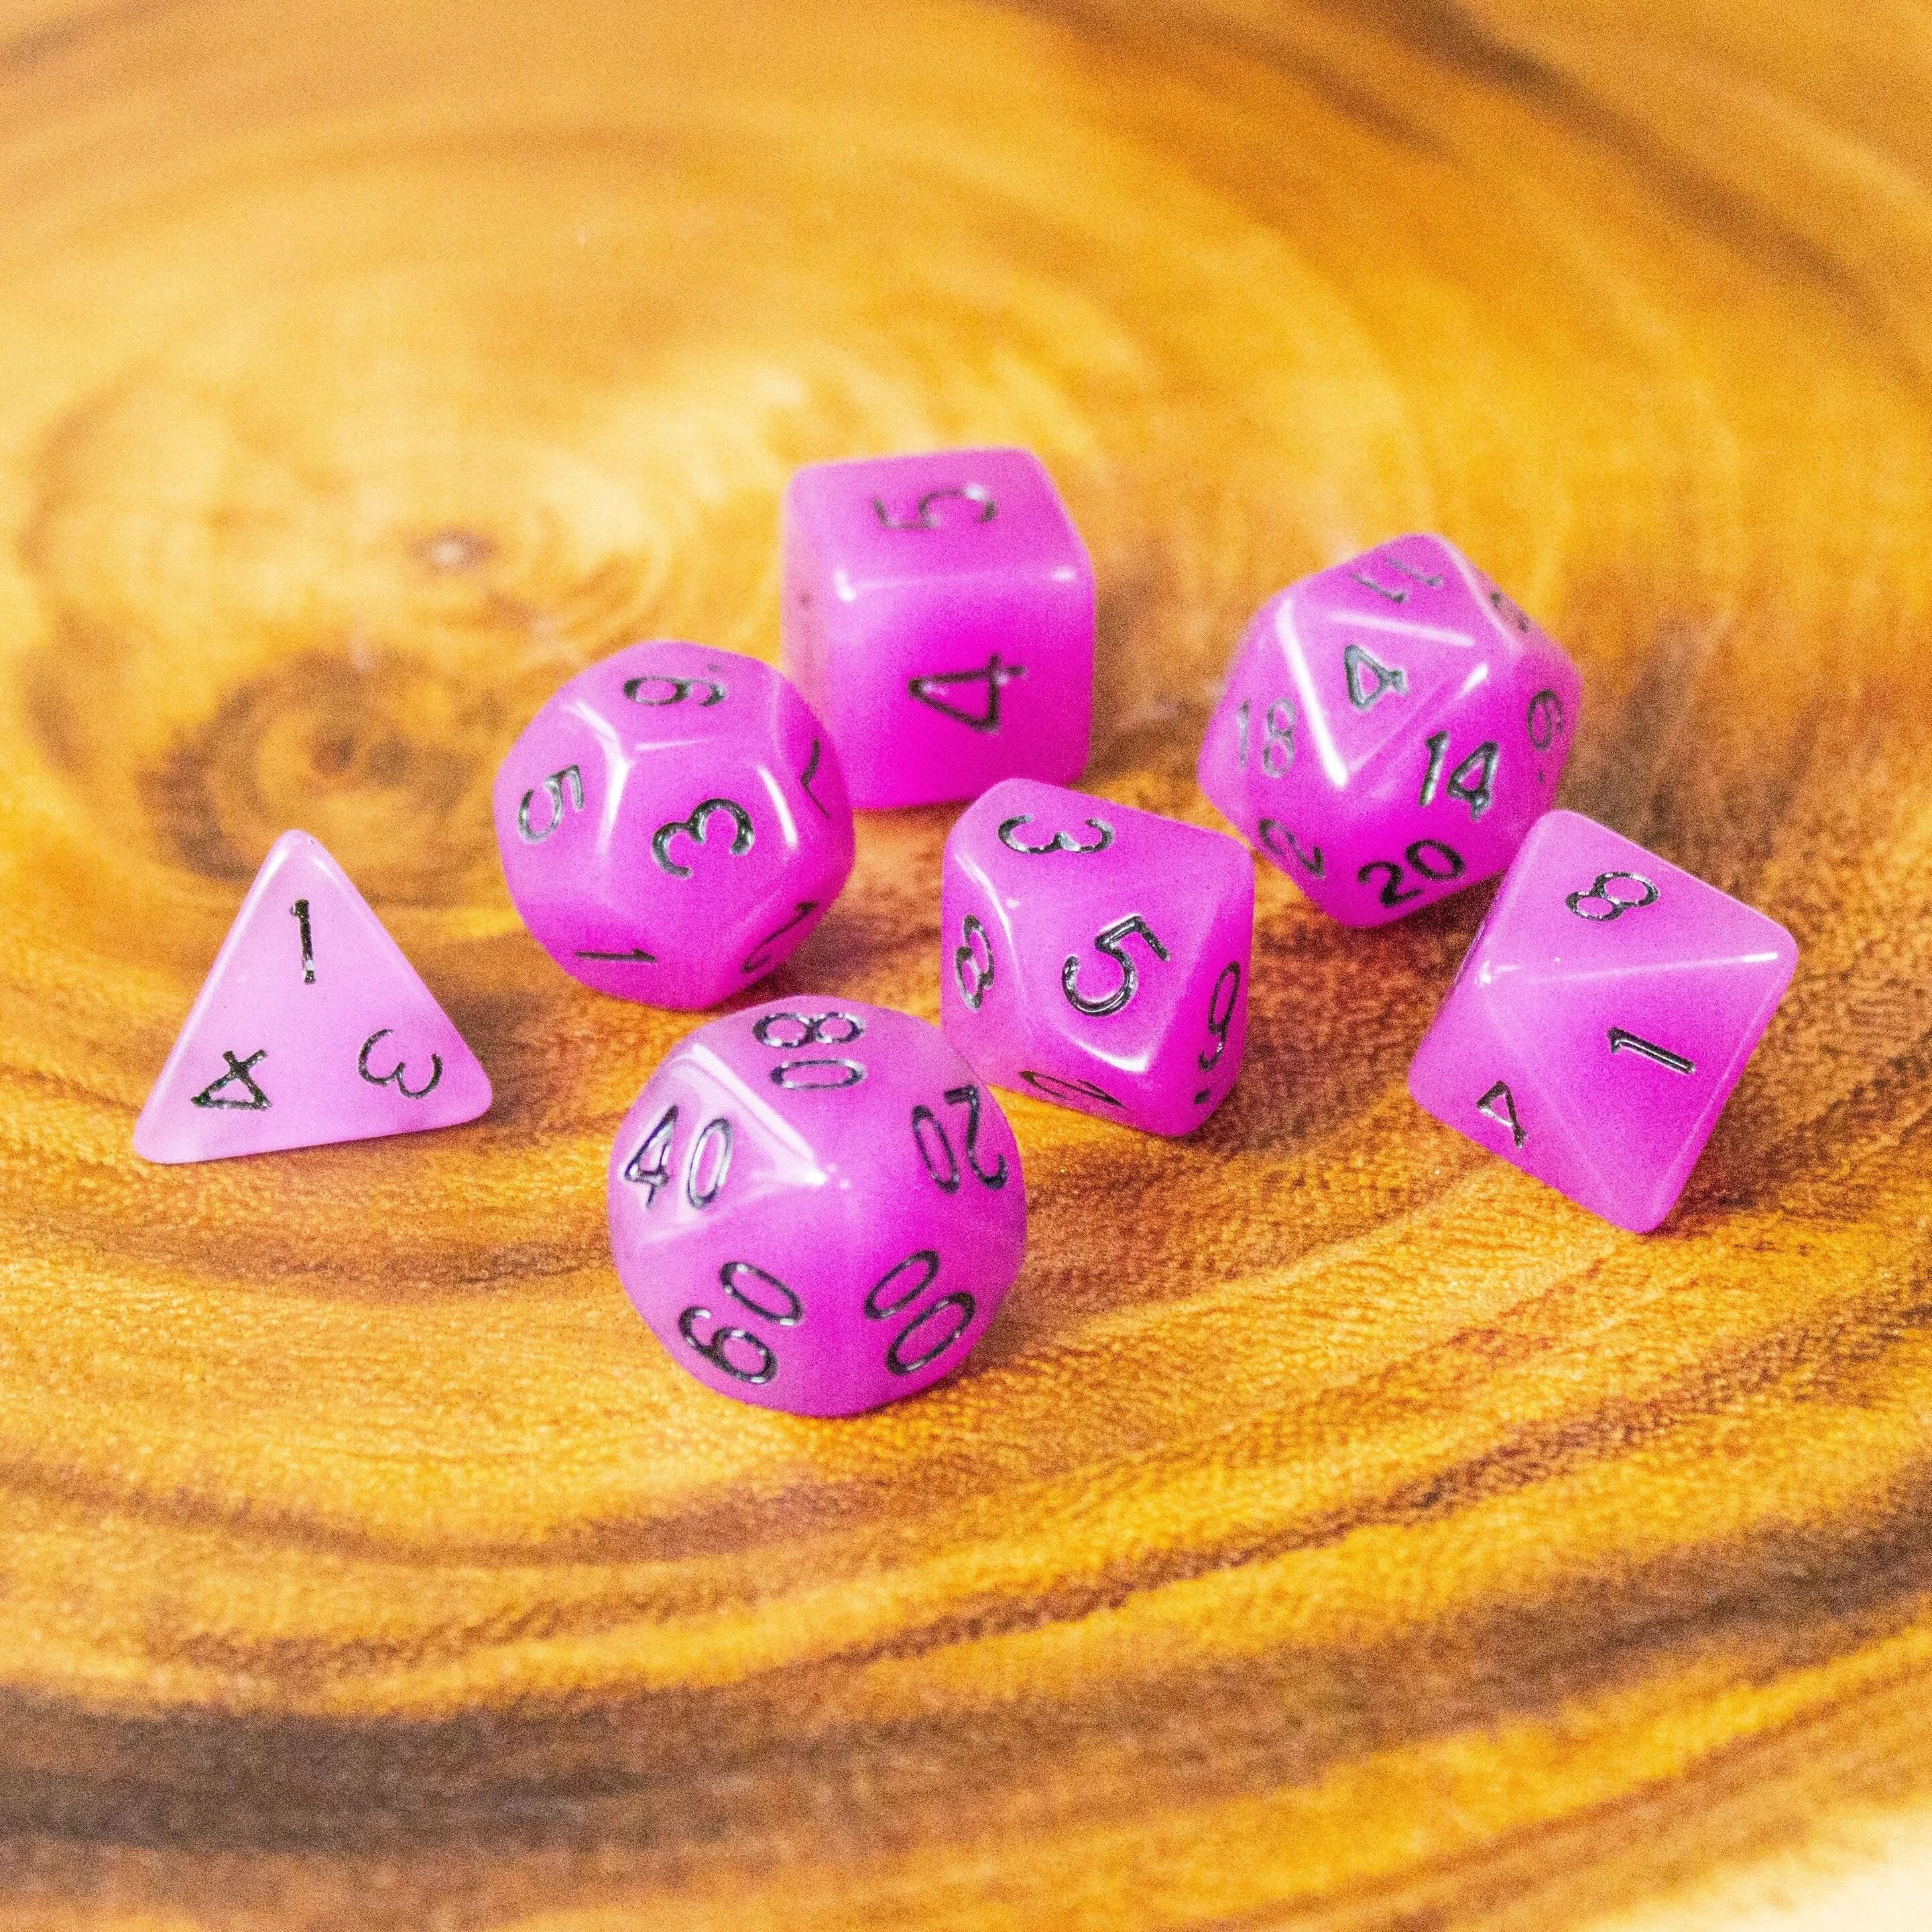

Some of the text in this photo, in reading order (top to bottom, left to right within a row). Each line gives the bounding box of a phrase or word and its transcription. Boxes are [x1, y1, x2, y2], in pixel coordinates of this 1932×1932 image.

[873, 484, 998, 530] 5
[1349, 556, 1443, 603] 11
[907, 653, 1026, 735] 4
[1343, 644, 1408, 711] 4
[1235, 697, 1298, 779] 18
[1418, 729, 1499, 822] 14
[518, 764, 585, 843] 5
[652, 797, 756, 880] 3
[998, 814, 1115, 855] 3
[1357, 838, 1467, 908] 20
[1566, 871, 1660, 922] 8
[290, 898, 316, 985] 1
[574, 947, 658, 964] 1
[955, 914, 995, 1014] 8
[1061, 914, 1171, 1016] 5
[190, 1048, 272, 1111] 4
[357, 1028, 444, 1099] 3
[751, 1011, 867, 1090] 80
[1608, 1026, 1697, 1075] 1
[623, 1105, 735, 1209] 40
[911, 1083, 1008, 1195] 20
[678, 1260, 804, 1385] 60
[864, 1249, 977, 1377] 00
